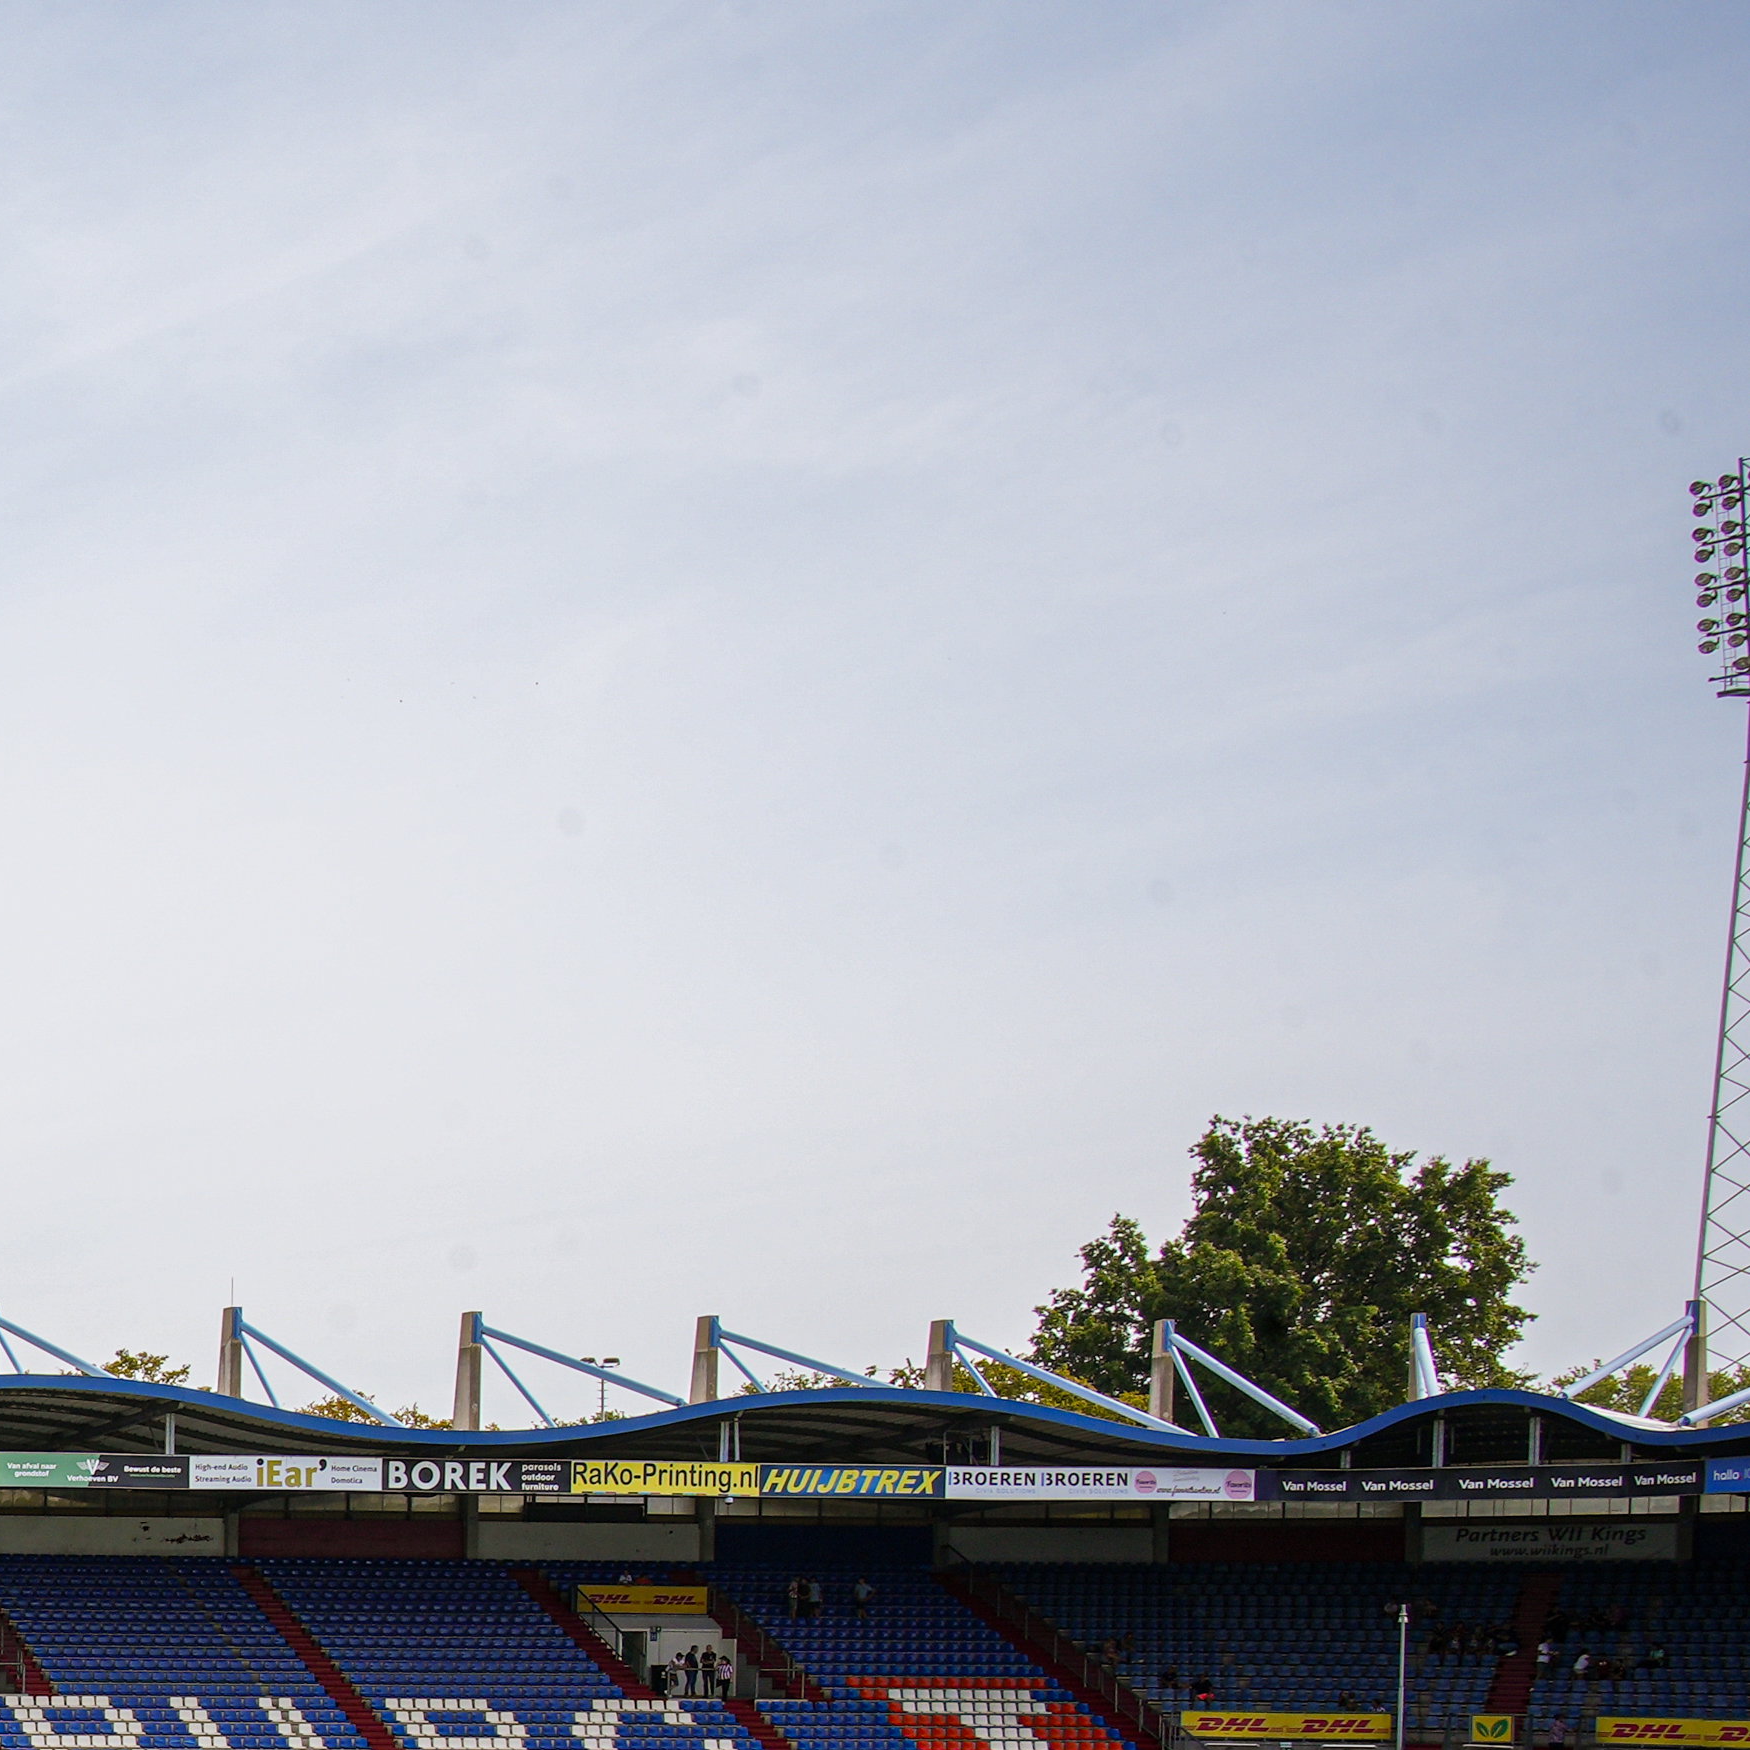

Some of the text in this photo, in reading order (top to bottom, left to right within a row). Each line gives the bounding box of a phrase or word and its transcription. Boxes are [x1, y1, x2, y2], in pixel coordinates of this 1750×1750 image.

[194, 1463, 249, 1474] High-end Audio
[330, 1463, 378, 1474] Home Cinema
[520, 1461, 563, 1474] parasols
[14, 1469, 50, 1479] grondstof
[387, 1459, 514, 1491] BOREK
[520, 1471, 557, 1482] outdoor
[571, 1462, 760, 1493] RaKo-Printing.nl
[948, 1471, 1036, 1487] BROEREN
[1041, 1471, 1129, 1487] BROEREN
[194, 1475, 252, 1486] Streaming Audio
[330, 1475, 364, 1487] Domotica
[520, 1481, 560, 1492] furniture
[760, 1467, 944, 1496] HUIJBTREX
[1195, 1717, 1272, 1733] DHL
